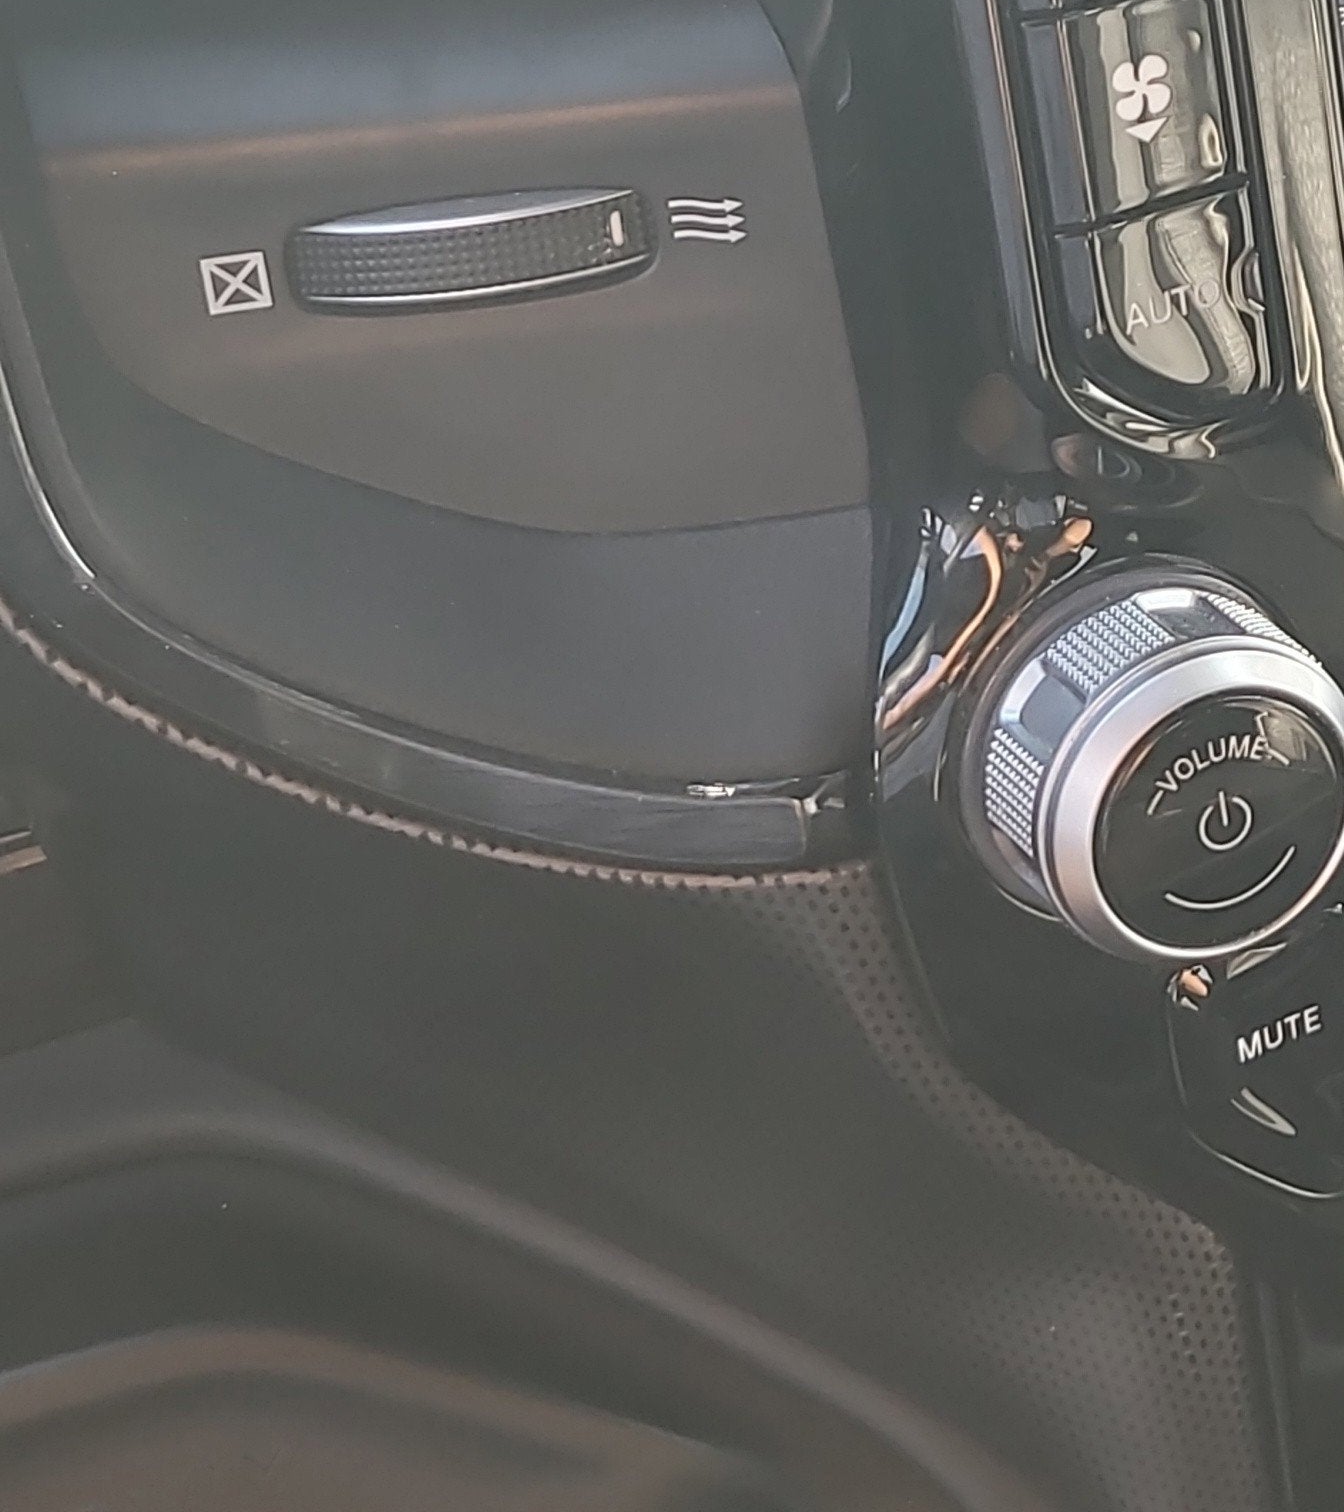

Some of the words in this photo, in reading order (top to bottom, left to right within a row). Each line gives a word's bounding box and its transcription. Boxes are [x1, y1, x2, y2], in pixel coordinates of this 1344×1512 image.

[1126, 279, 1220, 336] AUTO
[1156, 734, 1268, 793] VOLUME
[1236, 1004, 1322, 1064] MUTE
